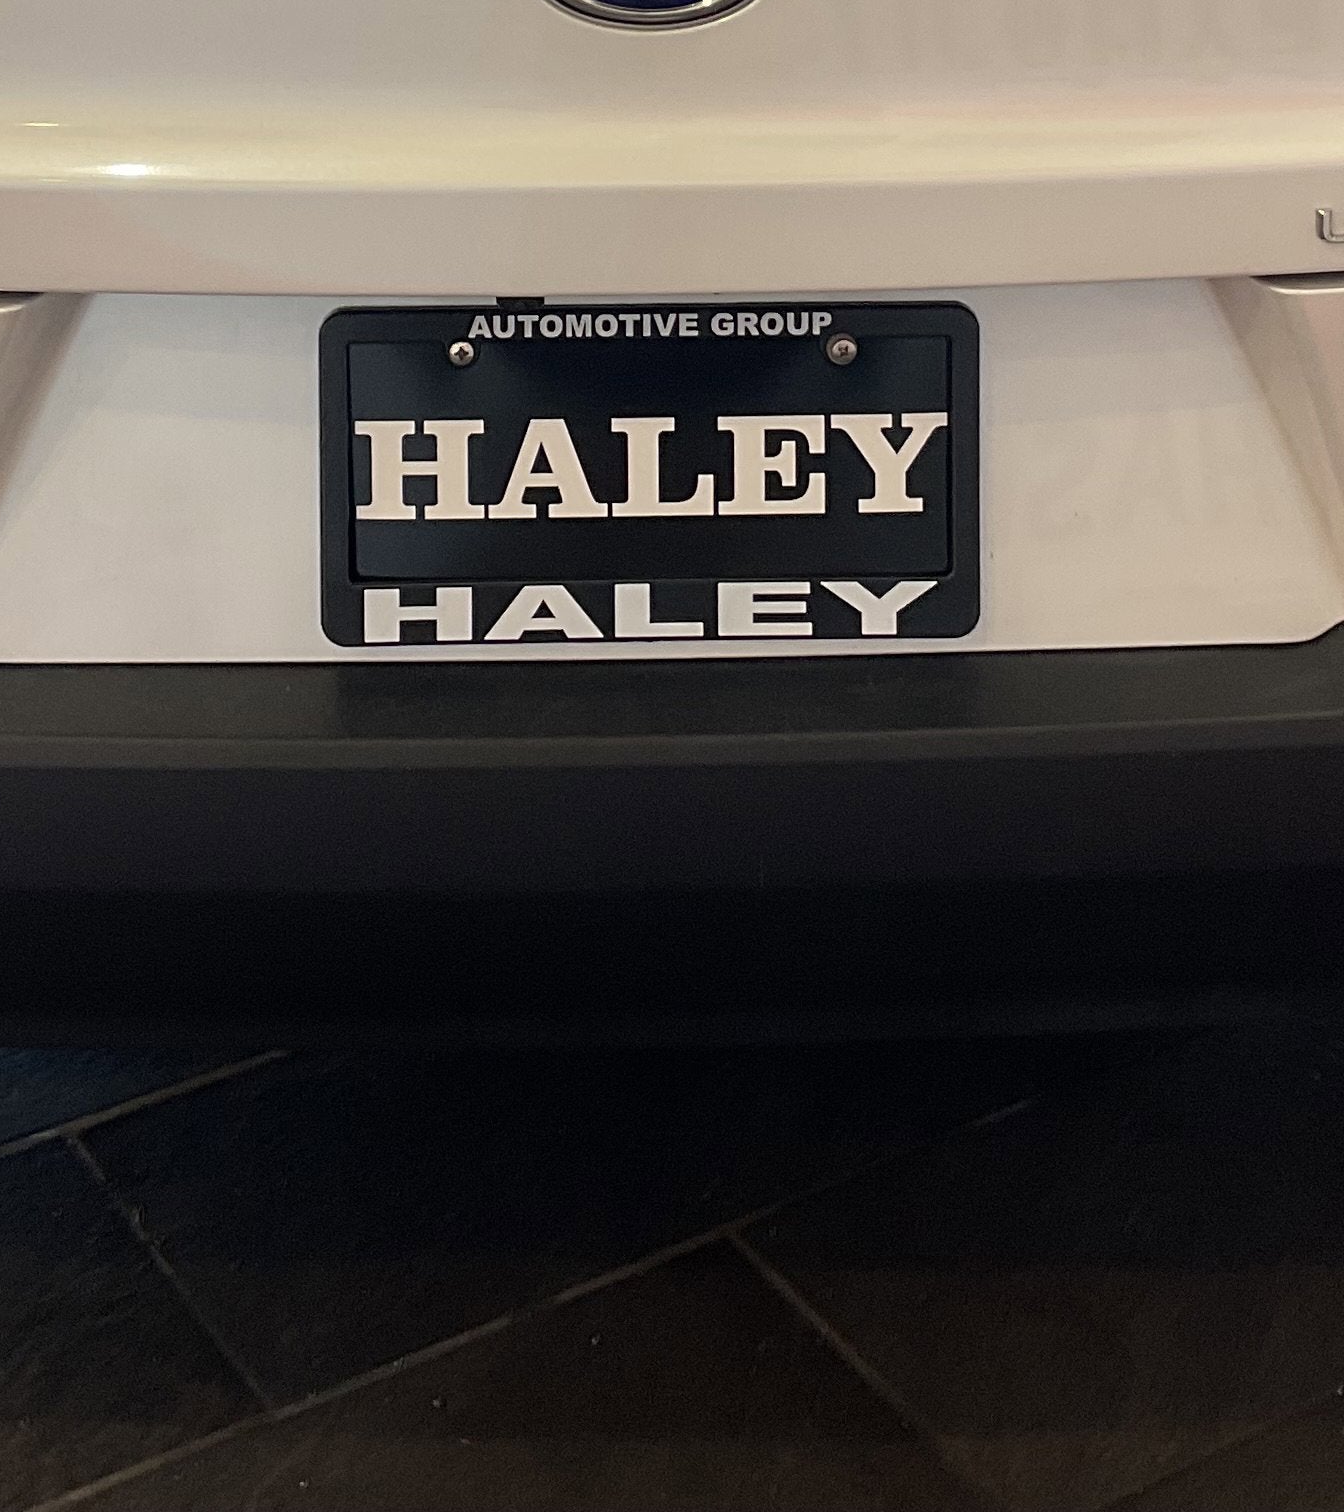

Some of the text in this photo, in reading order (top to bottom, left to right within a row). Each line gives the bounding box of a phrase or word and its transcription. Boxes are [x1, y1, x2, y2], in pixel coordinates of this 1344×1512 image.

[467, 311, 833, 339] AUTOMOTIVE GROUP
[354, 411, 949, 521] HALEY
[363, 580, 939, 643] HALEY
